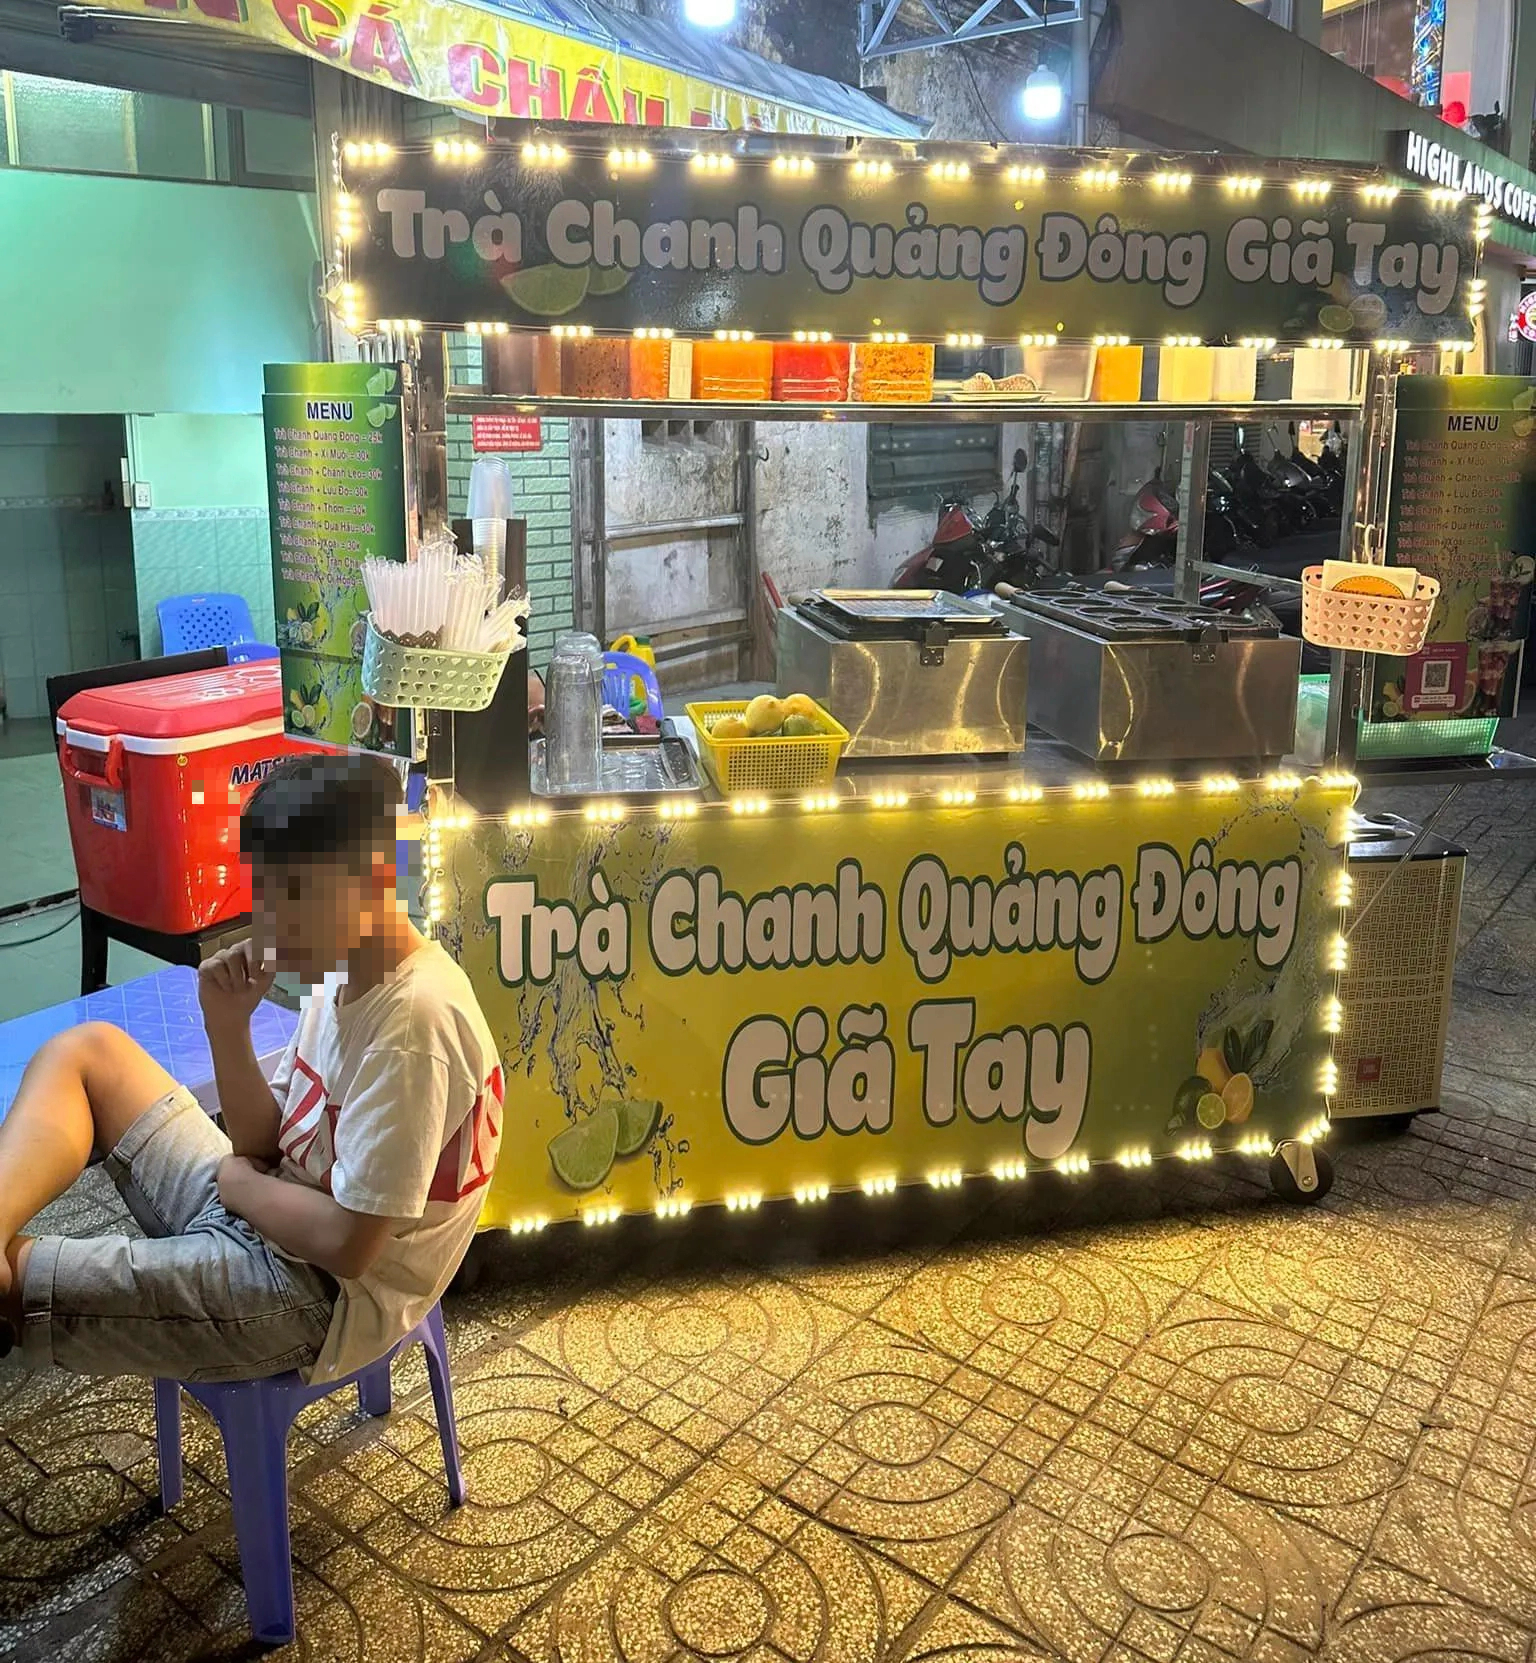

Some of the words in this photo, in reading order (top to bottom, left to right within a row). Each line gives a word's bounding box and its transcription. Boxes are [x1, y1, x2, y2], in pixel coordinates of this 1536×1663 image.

[271, 0, 420, 88] CÁ
[1406, 130, 1505, 209] HIGHLANDS
[1504, 182, 1536, 227] COFF
[376, 188, 523, 264] Trà
[544, 198, 784, 273] Chanh
[801, 202, 1026, 304] Quảng
[1036, 211, 1207, 307] Đông
[1225, 215, 1335, 286] Giã
[1346, 221, 1460, 315] Tay
[306, 401, 354, 422] MENU
[1447, 415, 1499, 432] MENU
[231, 757, 288, 786] MAT
[485, 872, 630, 988] Trà
[648, 857, 888, 976] Chanh
[899, 841, 1124, 985] Quảng
[1132, 838, 1302, 972] Đông
[722, 1003, 896, 1146] Giã
[908, 997, 1093, 1163] Tay
